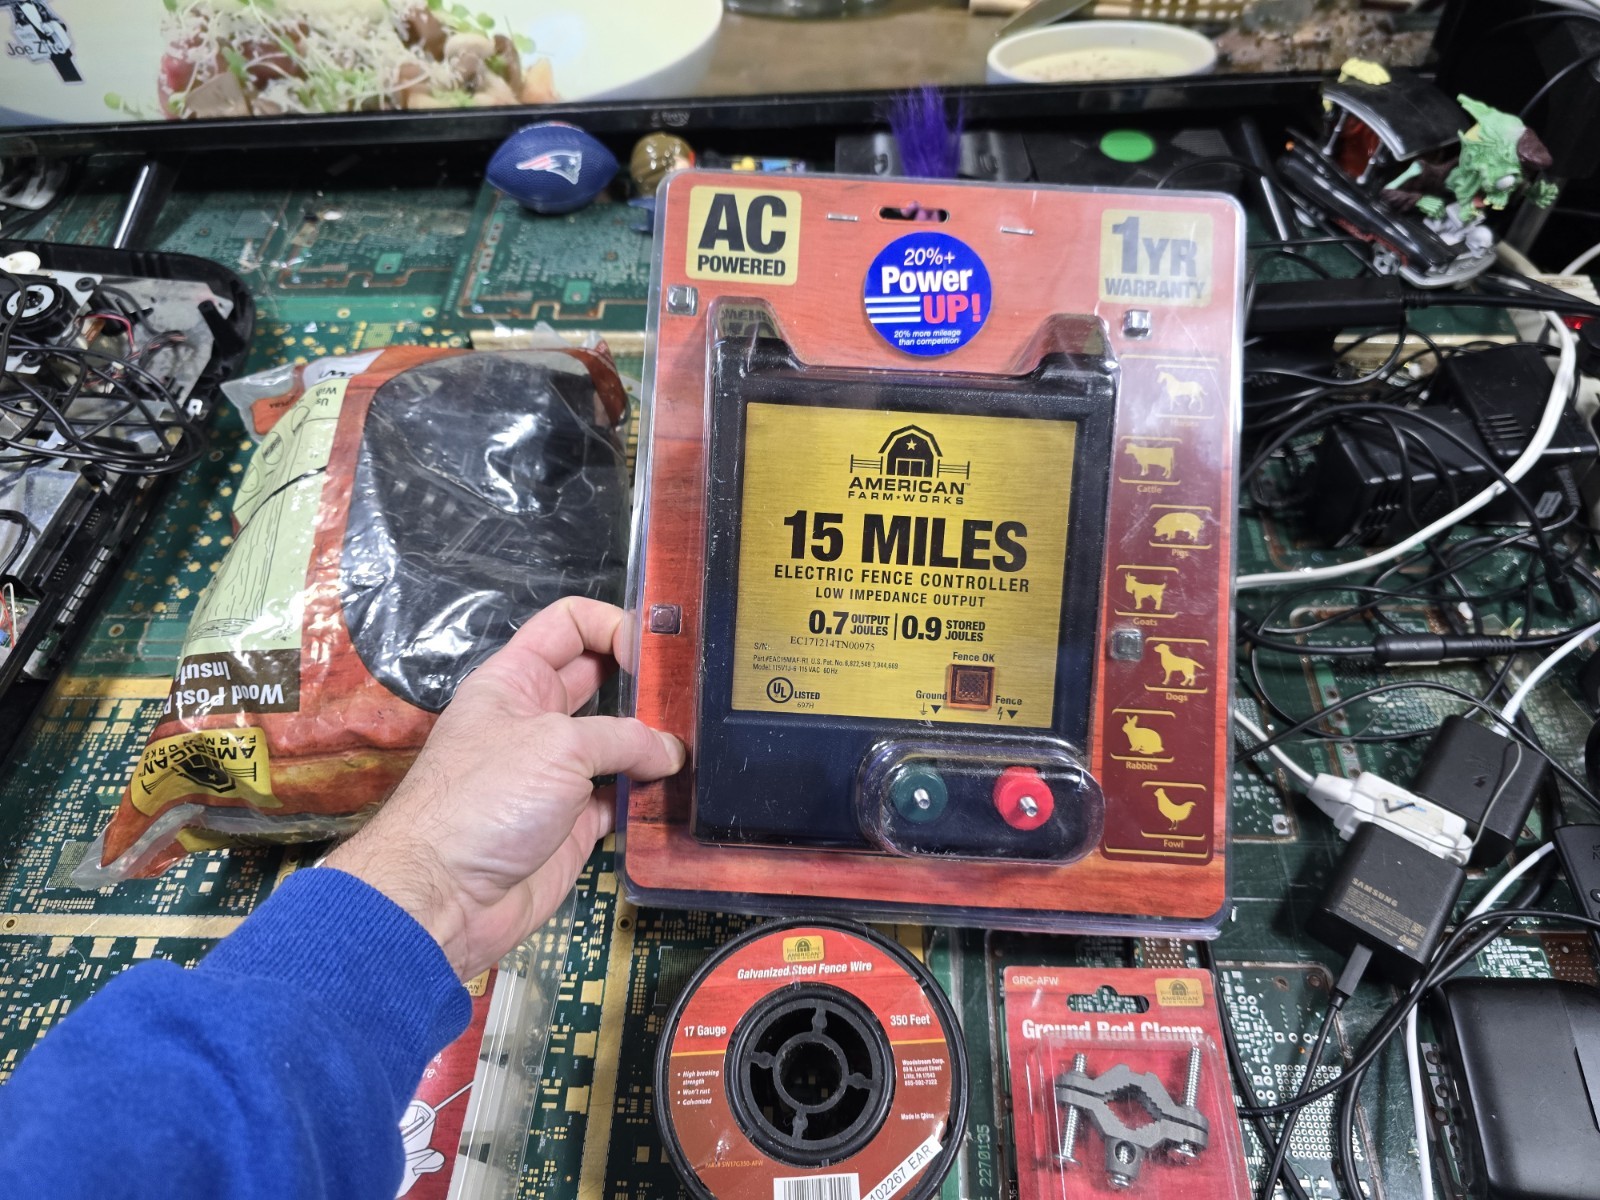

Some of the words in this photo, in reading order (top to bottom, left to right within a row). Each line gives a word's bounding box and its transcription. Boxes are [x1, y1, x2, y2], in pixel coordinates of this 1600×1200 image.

[7, 43, 33, 55] Joe
[698, 193, 787, 254] AC
[903, 247, 955, 266] 20%+
[697, 254, 786, 277] POWERED
[881, 266, 973, 294] Power
[1104, 278, 1206, 299] WARRANTY
[923, 293, 981, 324] UP!
[894, 330, 911, 338] 20%
[932, 329, 961, 338] mileage
[899, 338, 915, 346] than
[916, 337, 959, 346] competition
[849, 476, 965, 495] AMERICAN
[1136, 484, 1162, 494] Cattle
[848, 491, 894, 501] FARM
[903, 494, 964, 505] WORKS
[784, 510, 844, 562] 15
[861, 514, 1027, 573] MILES
[1171, 548, 1189, 559] Pigs
[774, 564, 854, 582] ELECTRIC
[861, 569, 914, 586] FENCE
[921, 573, 1030, 593] CONTROLLER
[815, 586, 844, 599] LOW
[850, 588, 928, 605] IMPEDANCE
[933, 594, 986, 607] OUTPUT
[808, 609, 850, 635] 0.7
[851, 613, 890, 625] OUTPUT
[902, 615, 942, 641] 0.9
[946, 620, 986, 631] STORED
[1133, 617, 1158, 627] Goats
[850, 625, 888, 636] JOULES
[945, 631, 984, 642] JOULES
[790, 636, 875, 651] EC171214TN00975
[952, 652, 980, 662] Fence
[982, 653, 996, 663] OK
[176, 687, 225, 706] Post
[231, 683, 284, 705] Wood
[794, 691, 820, 700] LISTED
[915, 690, 947, 701] Ground
[995, 695, 1023, 706] Fence
[1165, 692, 1188, 703] Dogs
[205, 735, 257, 745] FARM
[145, 740, 198, 761] WORKS
[142, 746, 257, 776] AMERICAN
[1125, 761, 1158, 771] Rabbits
[1163, 839, 1184, 849] Fowl
[1351, 877, 1399, 908] SAMSUNG
[737, 966, 791, 979] Galvanized
[792, 964, 816, 976] Steel
[819, 963, 848, 974] Fence
[850, 961, 872, 972] Wire
[1011, 975, 1060, 986] GRC-AFW
[890, 1015, 908, 1026] 350
[909, 1014, 931, 1026] Feet
[684, 1026, 695, 1037] 17
[697, 1025, 727, 1037] Gauge
[1022, 1019, 1092, 1039] Ground
[1096, 1021, 1135, 1041] Rod
[1141, 1021, 1204, 1041] Clamp
[682, 1070, 695, 1079] High
[696, 1069, 719, 1078] breaking
[682, 1078, 705, 1086] strength
[682, 1098, 712, 1106] Galvanized
[907, 1144, 934, 1170] EAR
